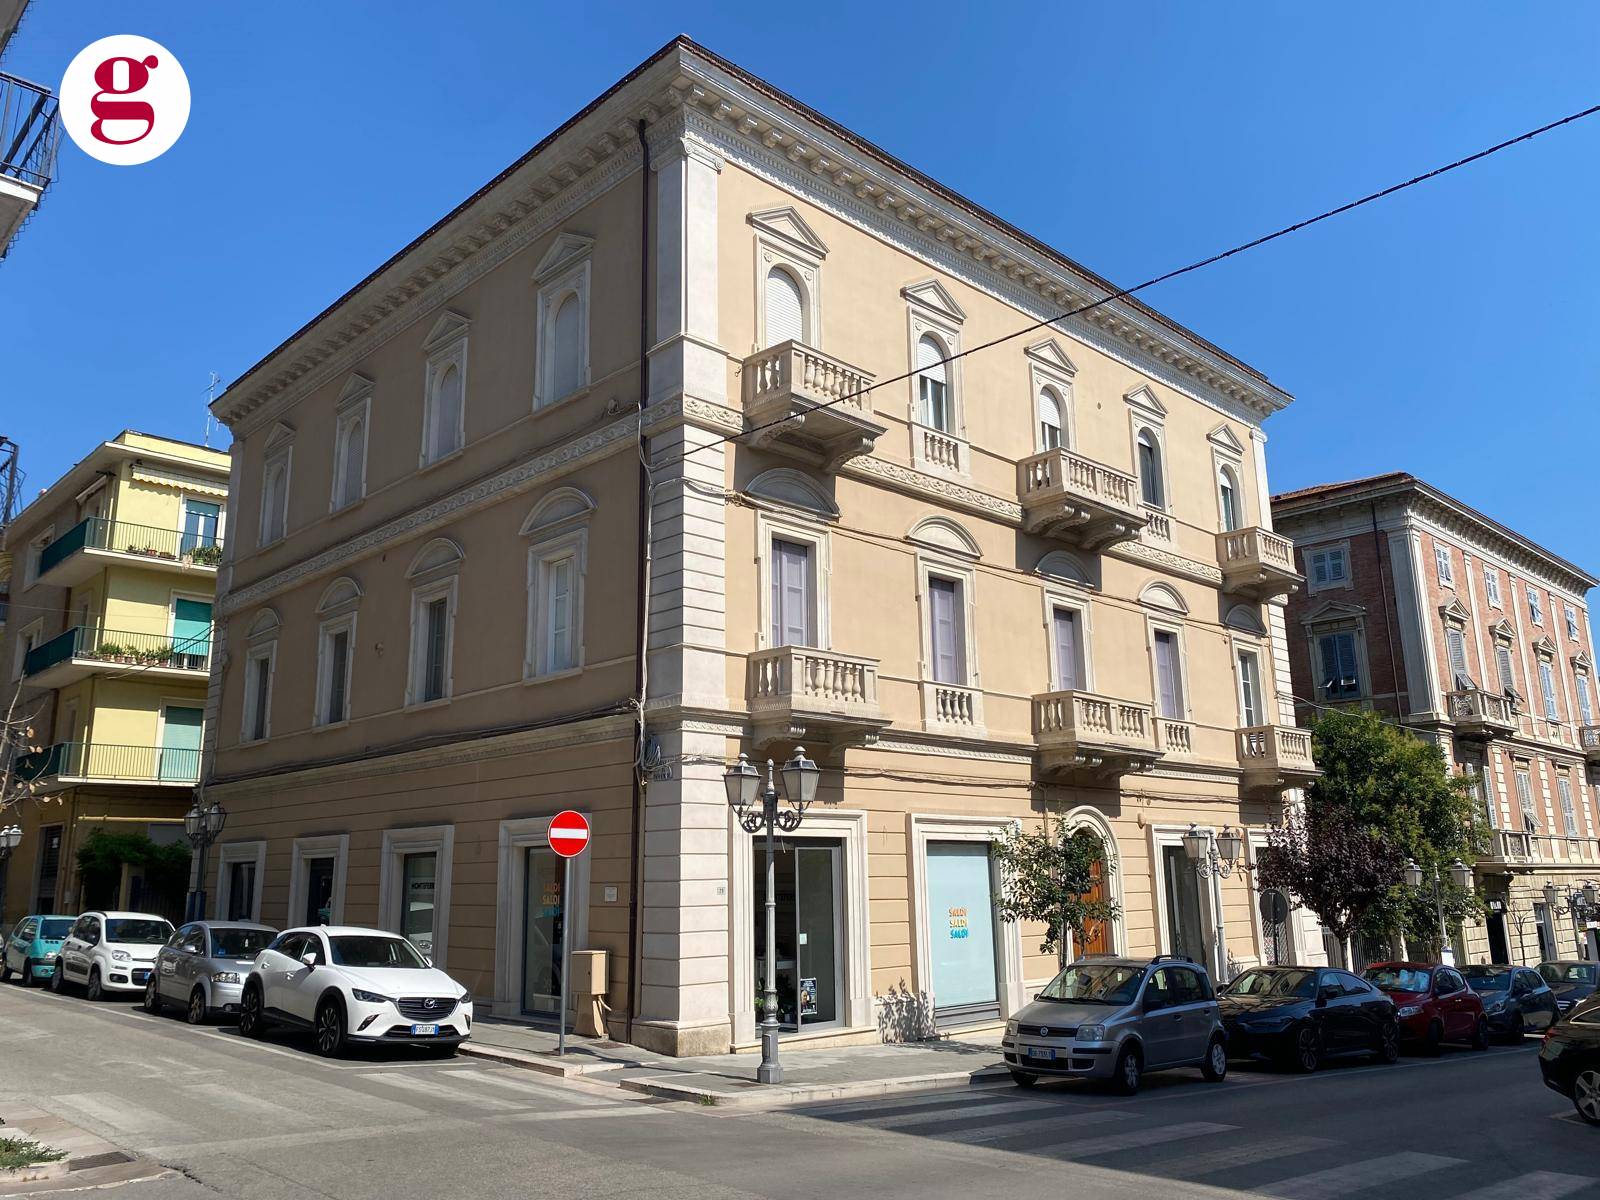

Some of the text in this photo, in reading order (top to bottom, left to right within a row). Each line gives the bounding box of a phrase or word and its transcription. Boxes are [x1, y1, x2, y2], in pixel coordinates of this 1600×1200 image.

[948, 907, 967, 917] SALDI
[949, 918, 967, 928] SALDI
[950, 928, 968, 939] SALDI
